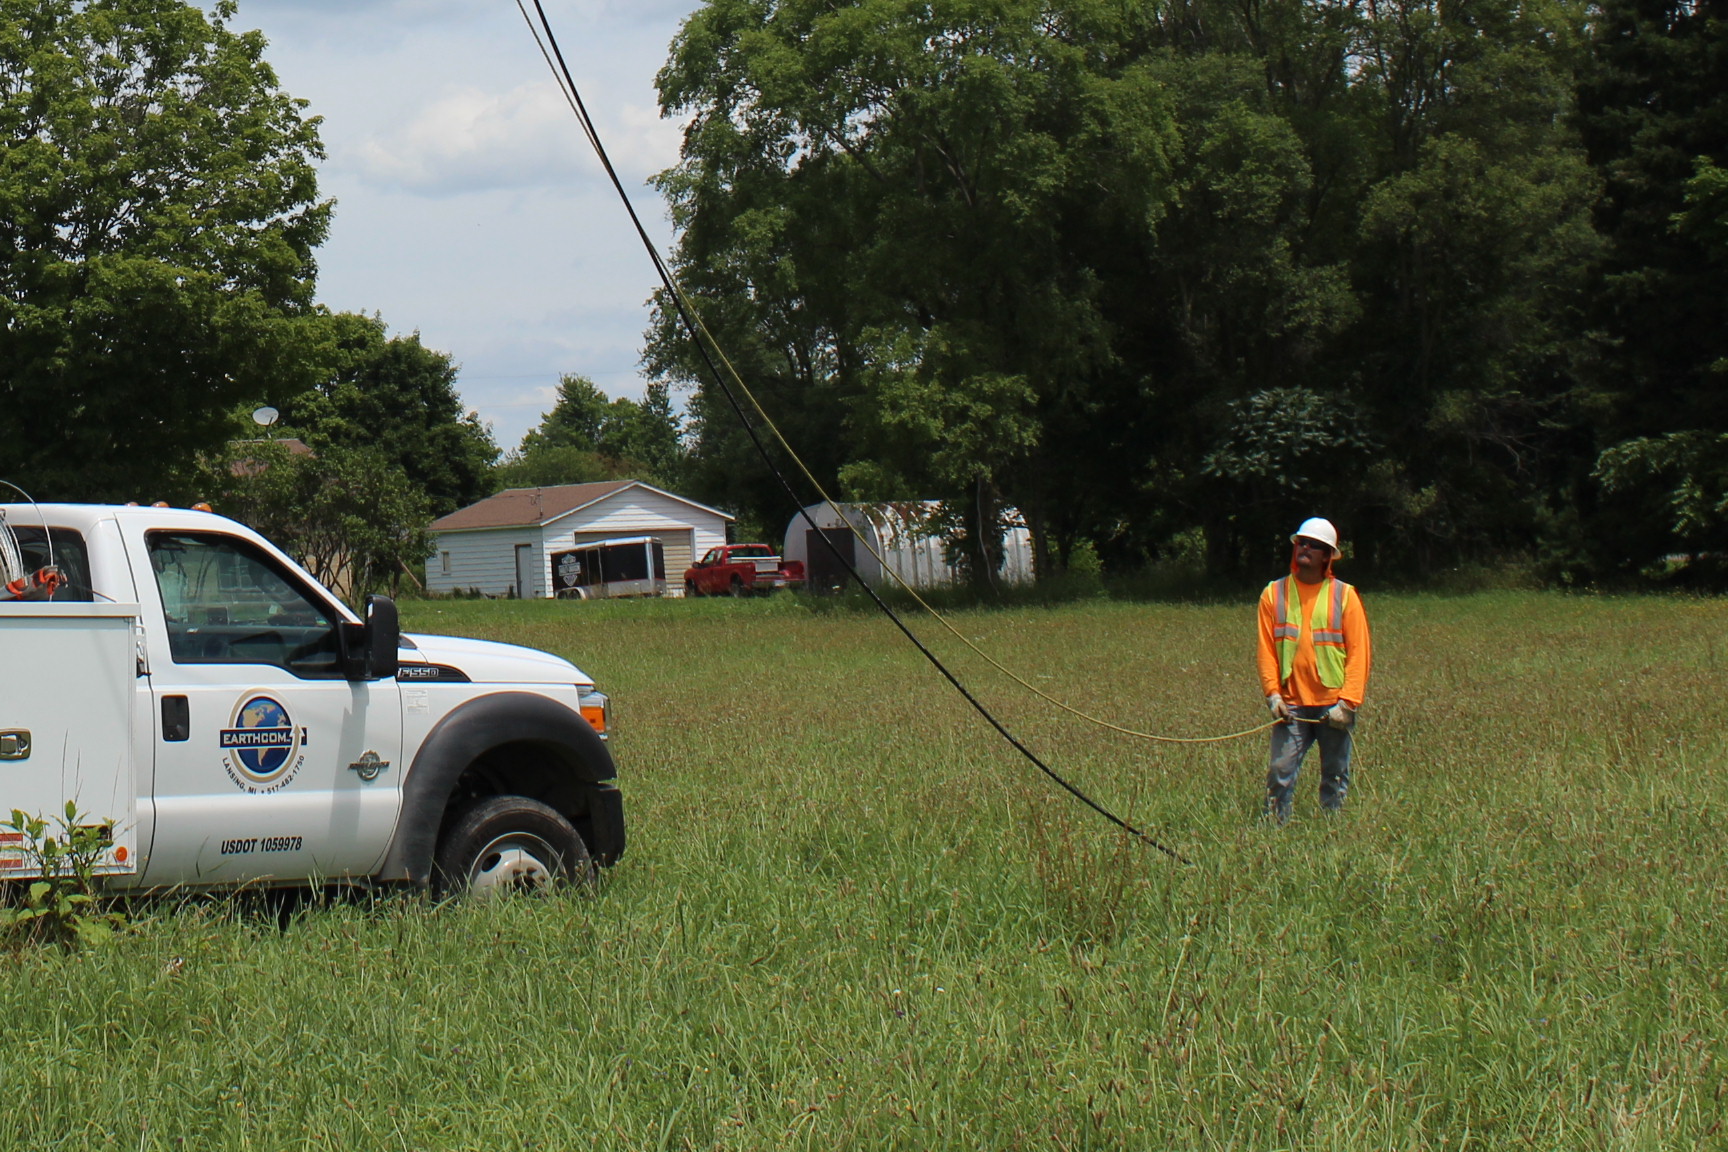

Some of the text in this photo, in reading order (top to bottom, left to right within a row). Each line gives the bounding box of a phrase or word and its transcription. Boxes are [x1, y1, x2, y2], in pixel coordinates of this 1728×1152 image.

[222, 754, 305, 795] LANSING, MI 517-482-1750
[221, 835, 303, 854] USDOT 1059978
